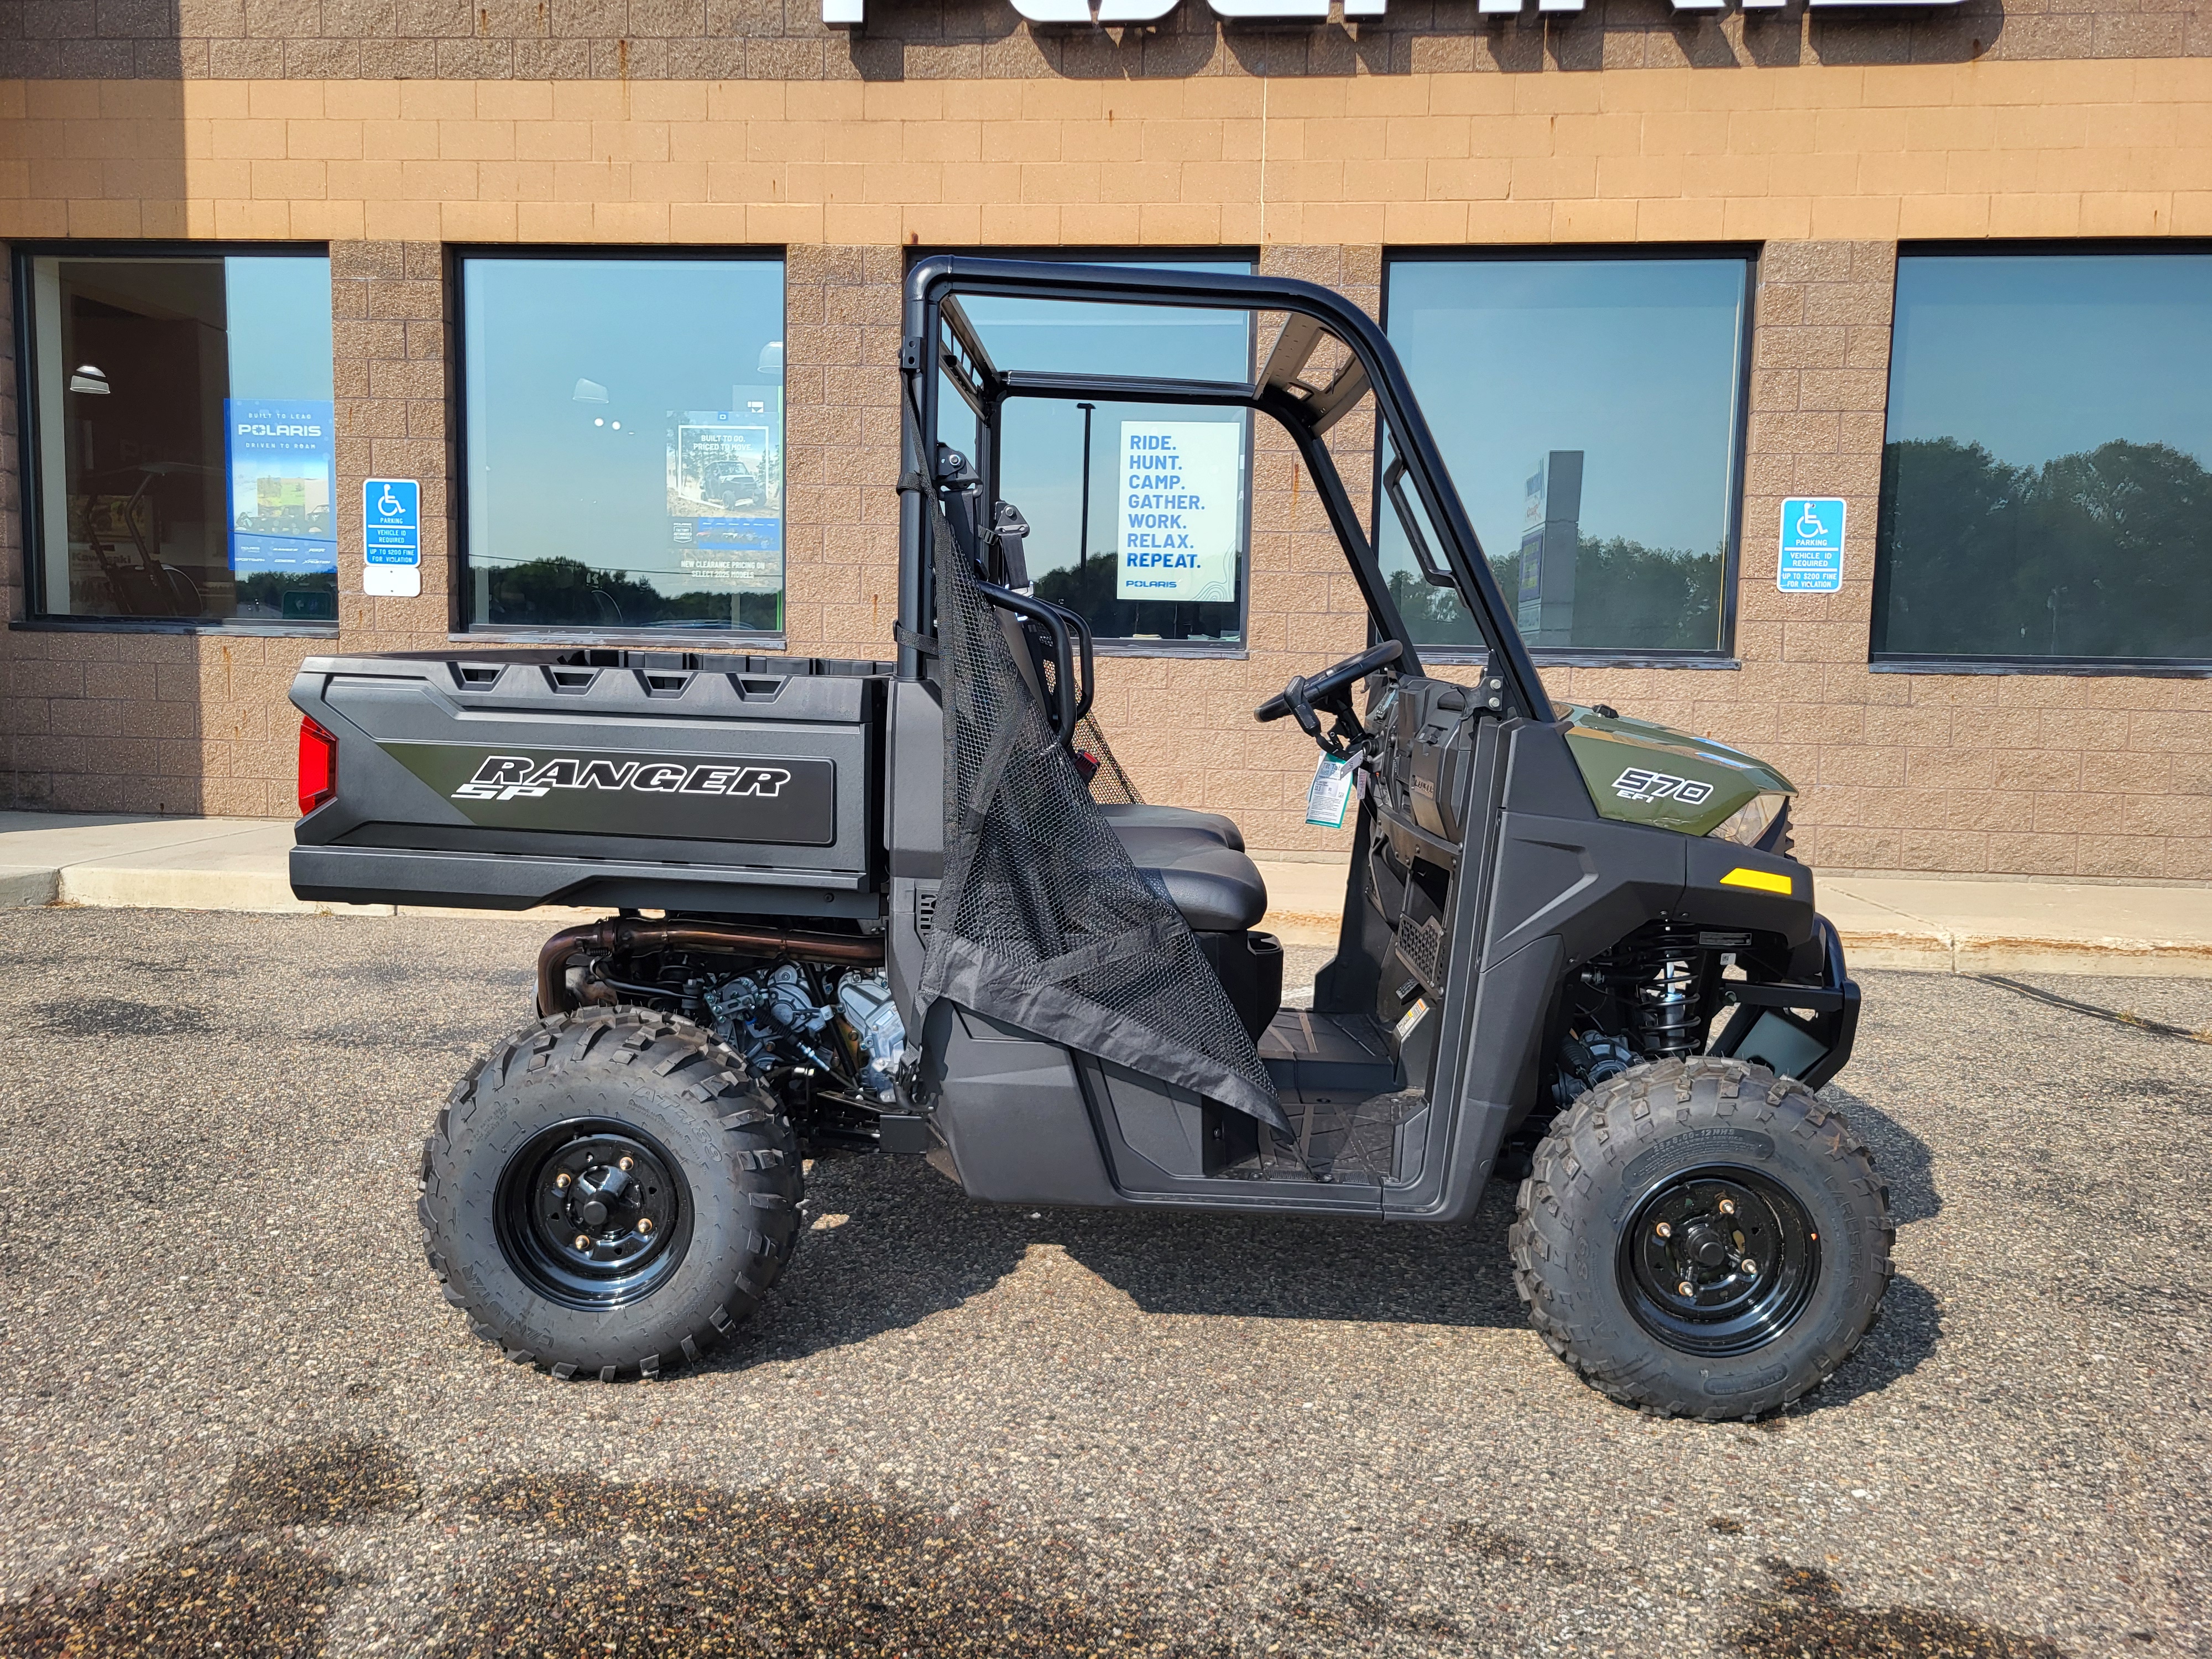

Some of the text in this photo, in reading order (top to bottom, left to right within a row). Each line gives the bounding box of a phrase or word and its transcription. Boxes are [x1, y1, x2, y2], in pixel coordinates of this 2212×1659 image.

[238, 424, 322, 437] POLARIS
[1130, 435, 1176, 450] RIDE.
[1129, 455, 1182, 470] HUNT.
[1129, 474, 1185, 489] CAMP.
[1128, 494, 1205, 510] GATHER.
[1128, 514, 1186, 529] WORK.
[1127, 533, 1194, 549] RELAX.
[1126, 552, 1201, 568] REPEAT.
[471, 755, 791, 797] RANGER
[451, 783, 550, 801] SP
[1611, 767, 1714, 805] 570
[1616, 790, 1654, 803] EFI
[1823, 1175, 1863, 1291] CARLSTAR
[461, 1263, 555, 1349] CARLSTAR
